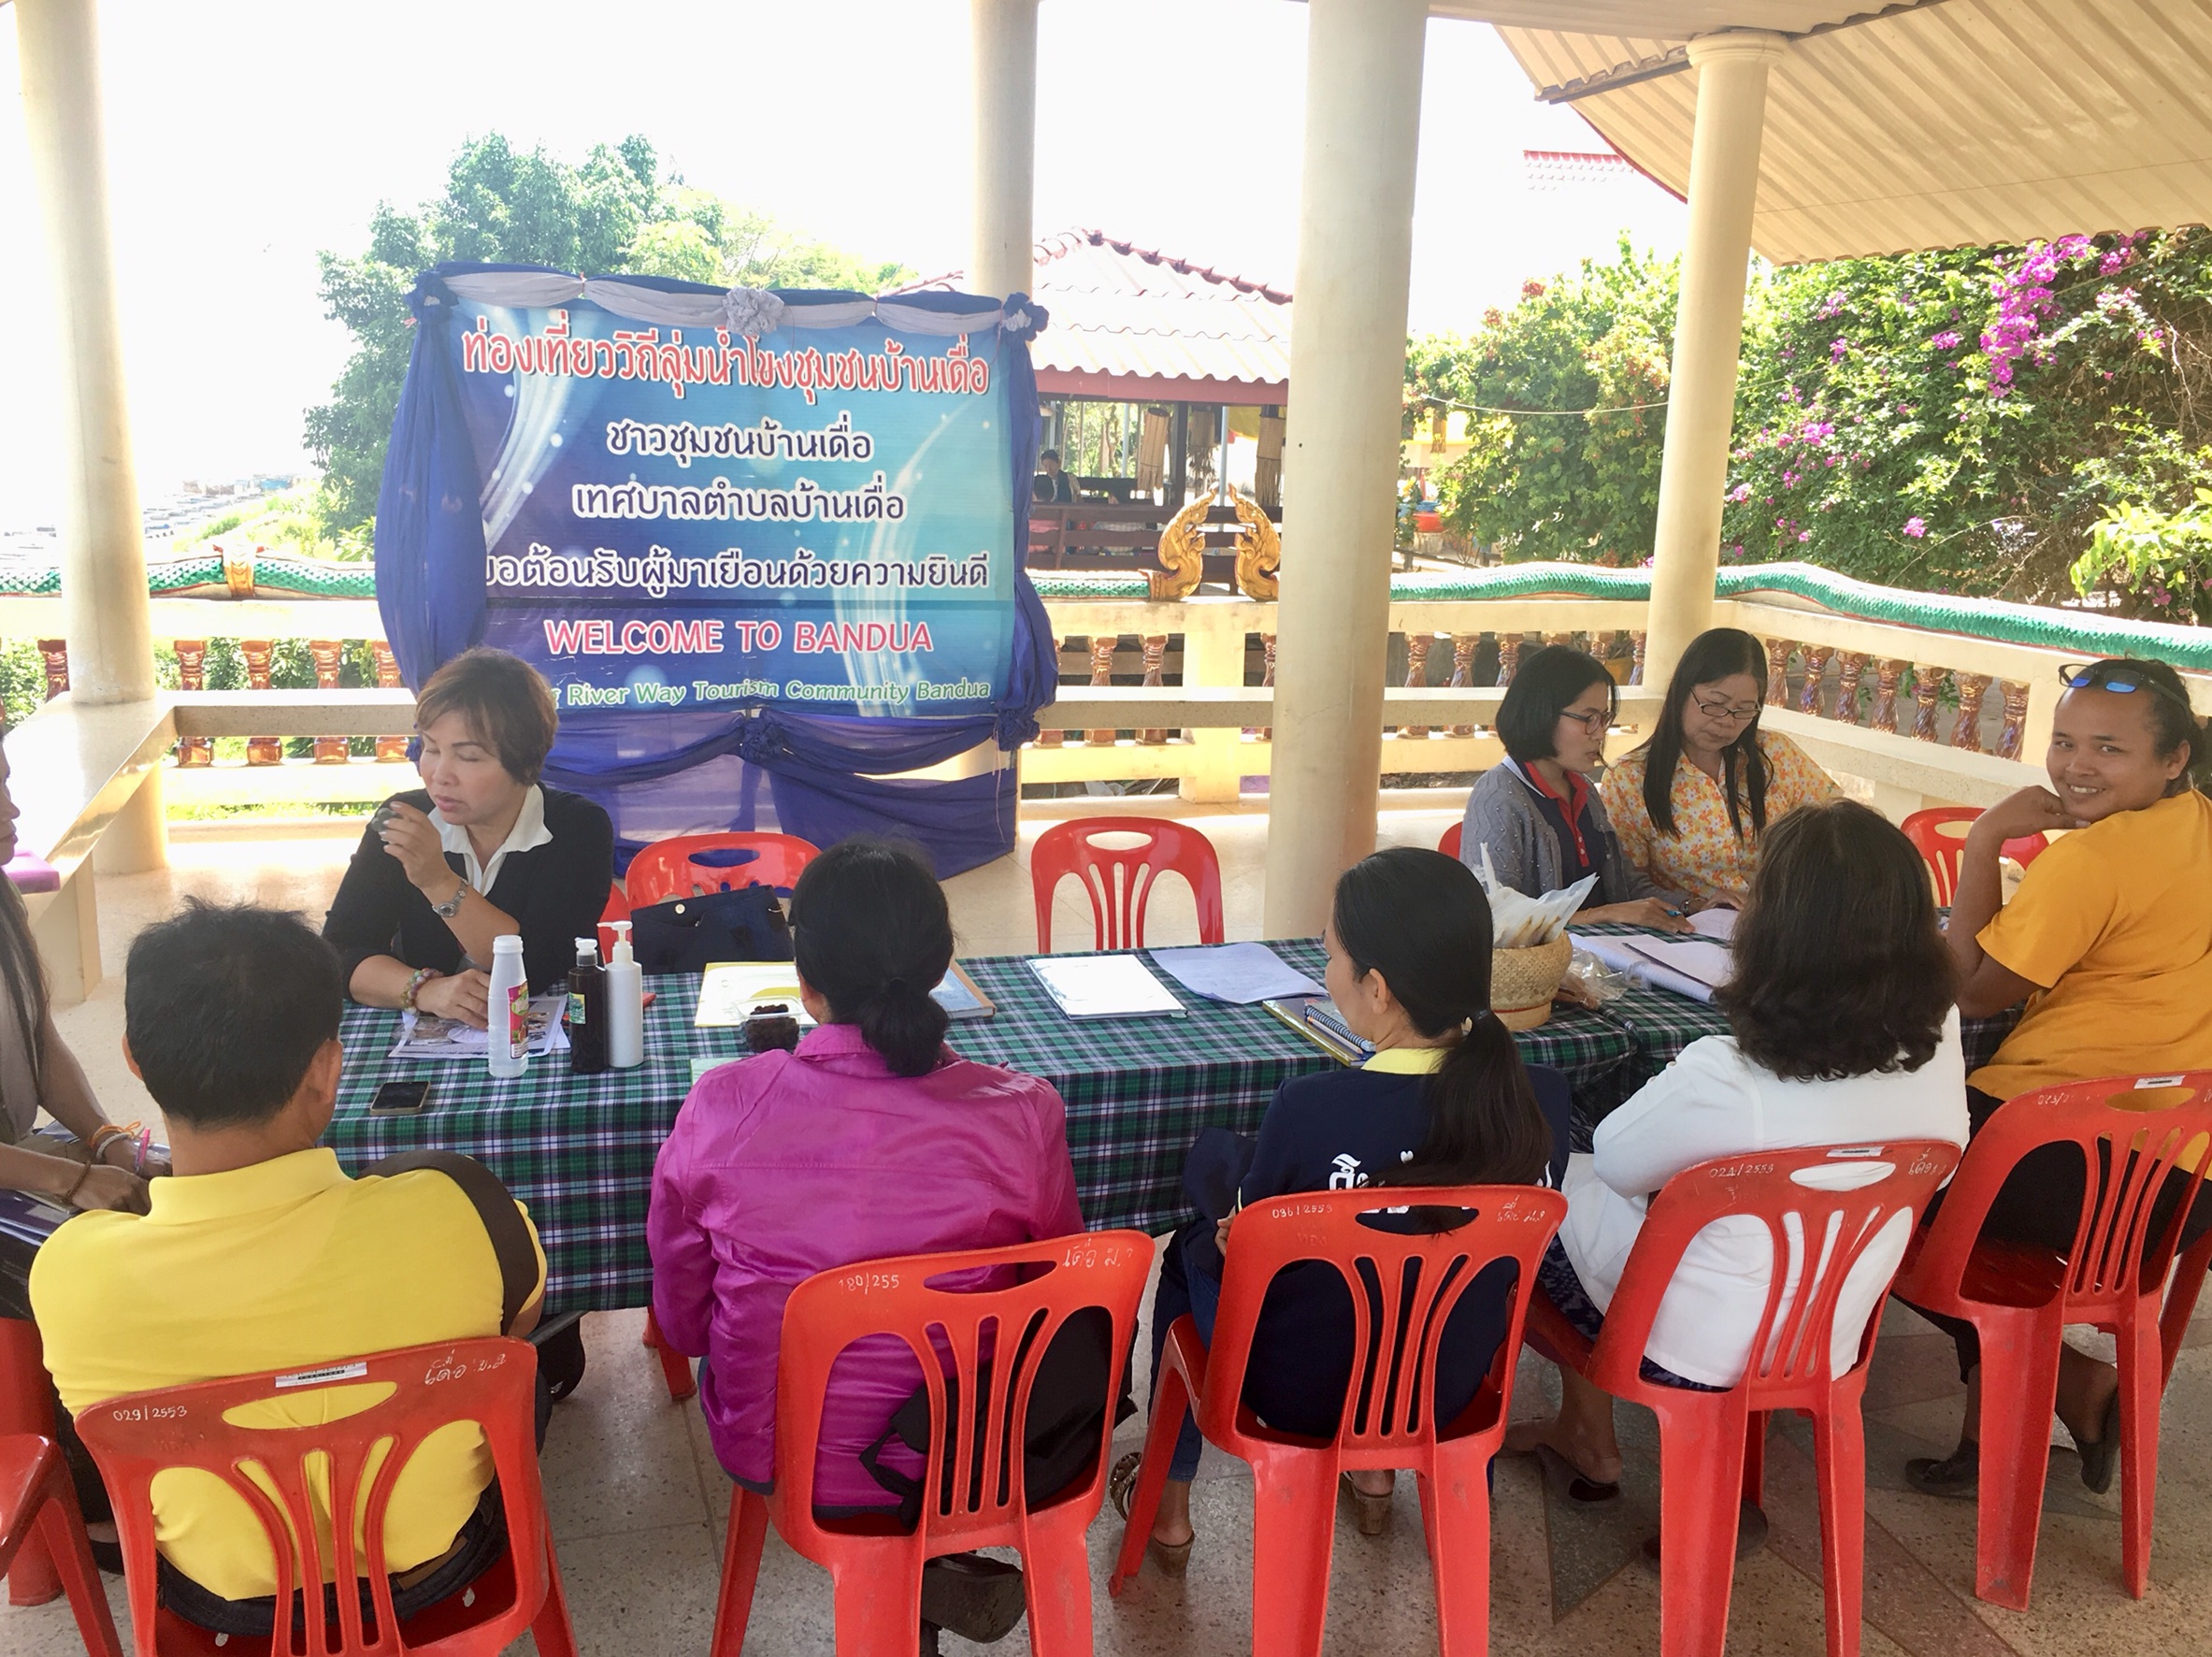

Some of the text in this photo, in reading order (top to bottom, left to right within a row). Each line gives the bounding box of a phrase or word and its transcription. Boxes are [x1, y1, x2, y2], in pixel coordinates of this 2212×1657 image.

[610, 411, 872, 466] ชาวชุมชนบ้านเดื่อ
[575, 473, 905, 521] เทศบาลตำบลบ้านเดื่อ
[545, 621, 934, 654] WELCOME TO BANDUA
[567, 684, 630, 705] River
[635, 684, 686, 705] Way
[693, 679, 779, 701] Tourism
[785, 679, 910, 704] Community
[915, 677, 991, 700] Bandua
